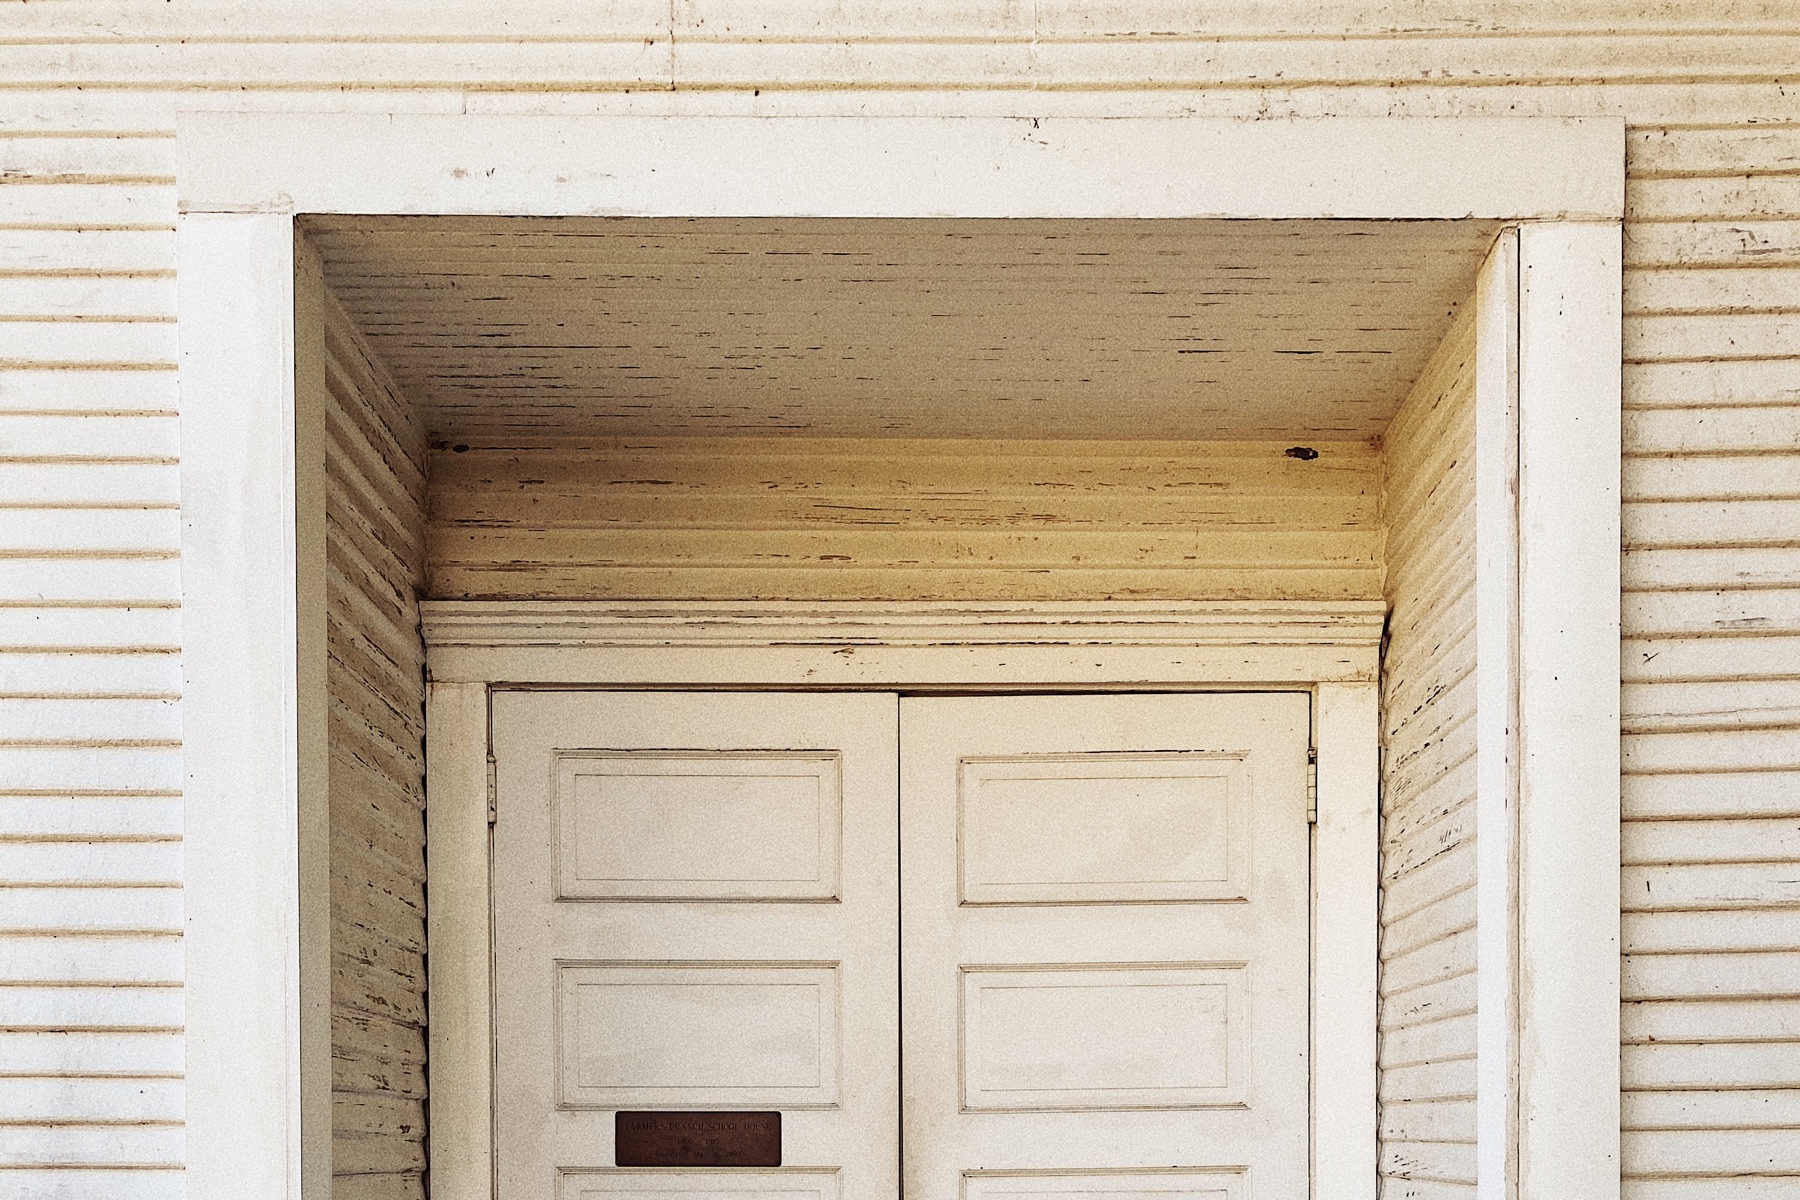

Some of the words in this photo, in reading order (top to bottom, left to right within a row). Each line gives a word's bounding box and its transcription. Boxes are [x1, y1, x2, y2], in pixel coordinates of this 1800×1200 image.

[669, 1122, 704, 1131] BRANCH
[708, 1122, 738, 1131] SCHOOL
[744, 1122, 771, 1131] HOUSE
